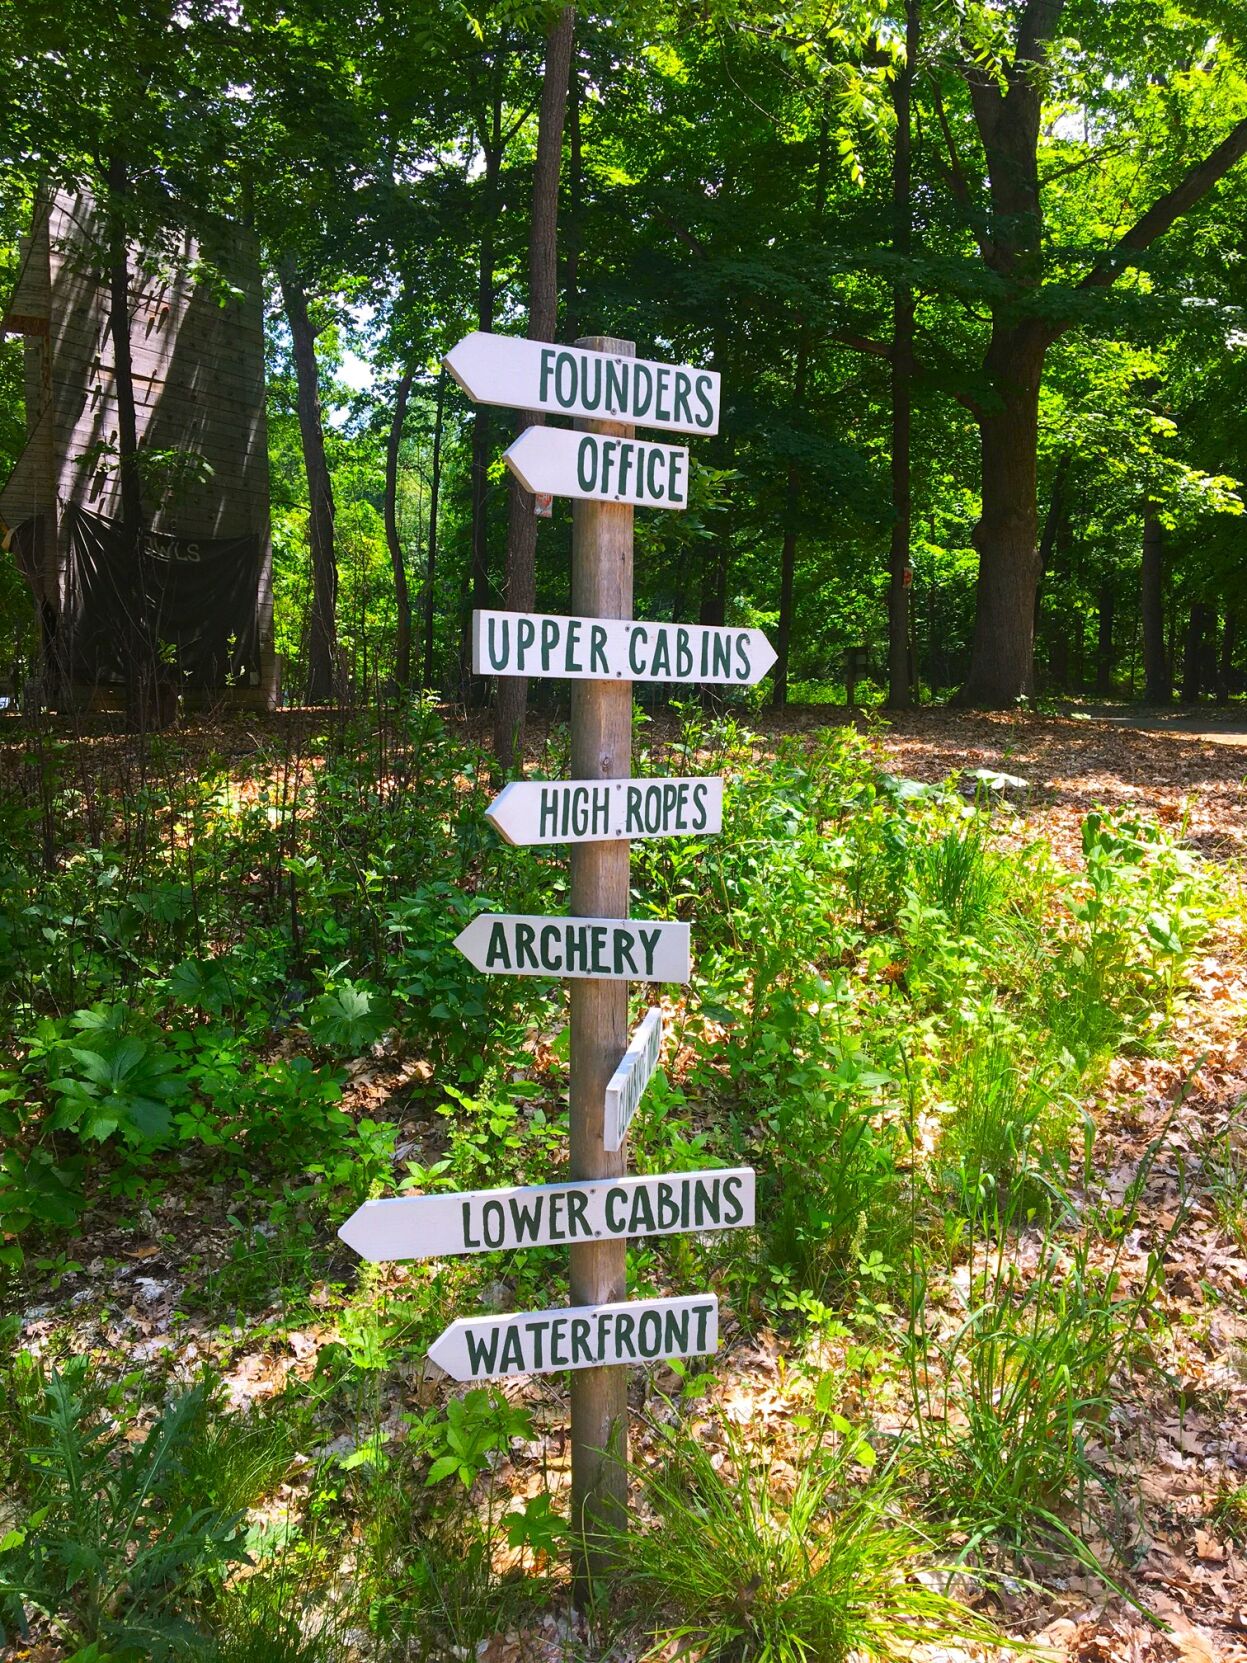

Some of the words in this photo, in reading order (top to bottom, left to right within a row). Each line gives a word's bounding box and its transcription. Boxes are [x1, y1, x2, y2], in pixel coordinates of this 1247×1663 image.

[539, 348, 713, 428] FOUNDERS
[577, 436, 684, 501] OFFICE
[488, 618, 610, 674] UPPER
[628, 627, 751, 680] CABINS
[540, 787, 610, 837] HIGH
[626, 783, 708, 833] ROPES
[486, 922, 662, 975] ARCHERY
[462, 1190, 592, 1248] LOWER
[605, 1176, 744, 1234] CABINS
[465, 1305, 713, 1376] WATERFRONT
